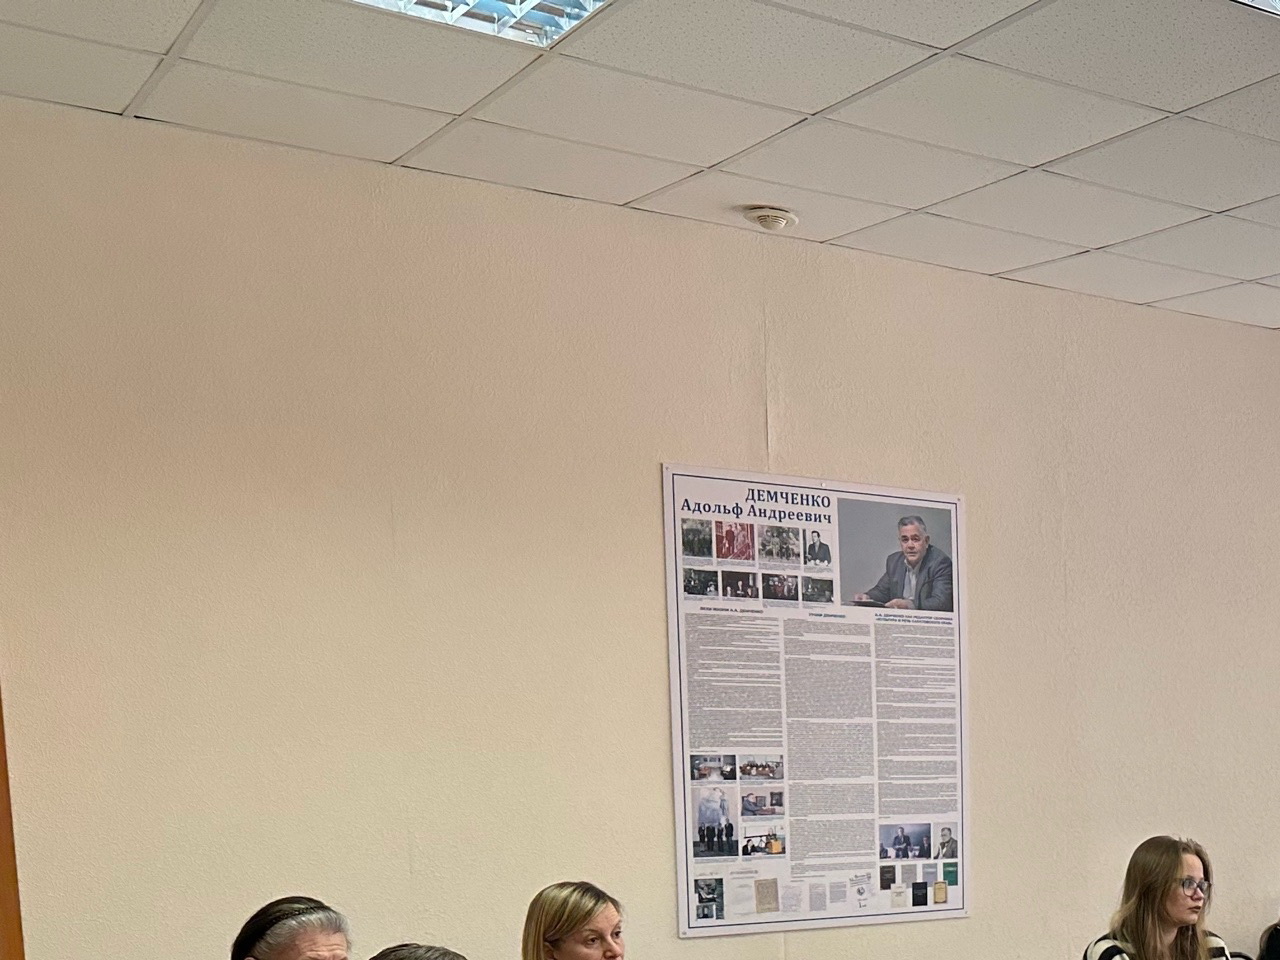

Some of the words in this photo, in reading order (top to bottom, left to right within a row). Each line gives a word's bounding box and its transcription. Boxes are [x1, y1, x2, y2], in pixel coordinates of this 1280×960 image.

[745, 487, 831, 508] ДЕМЧЕНКО
[680, 498, 743, 518] Адольф
[747, 504, 832, 524] Андреевич
